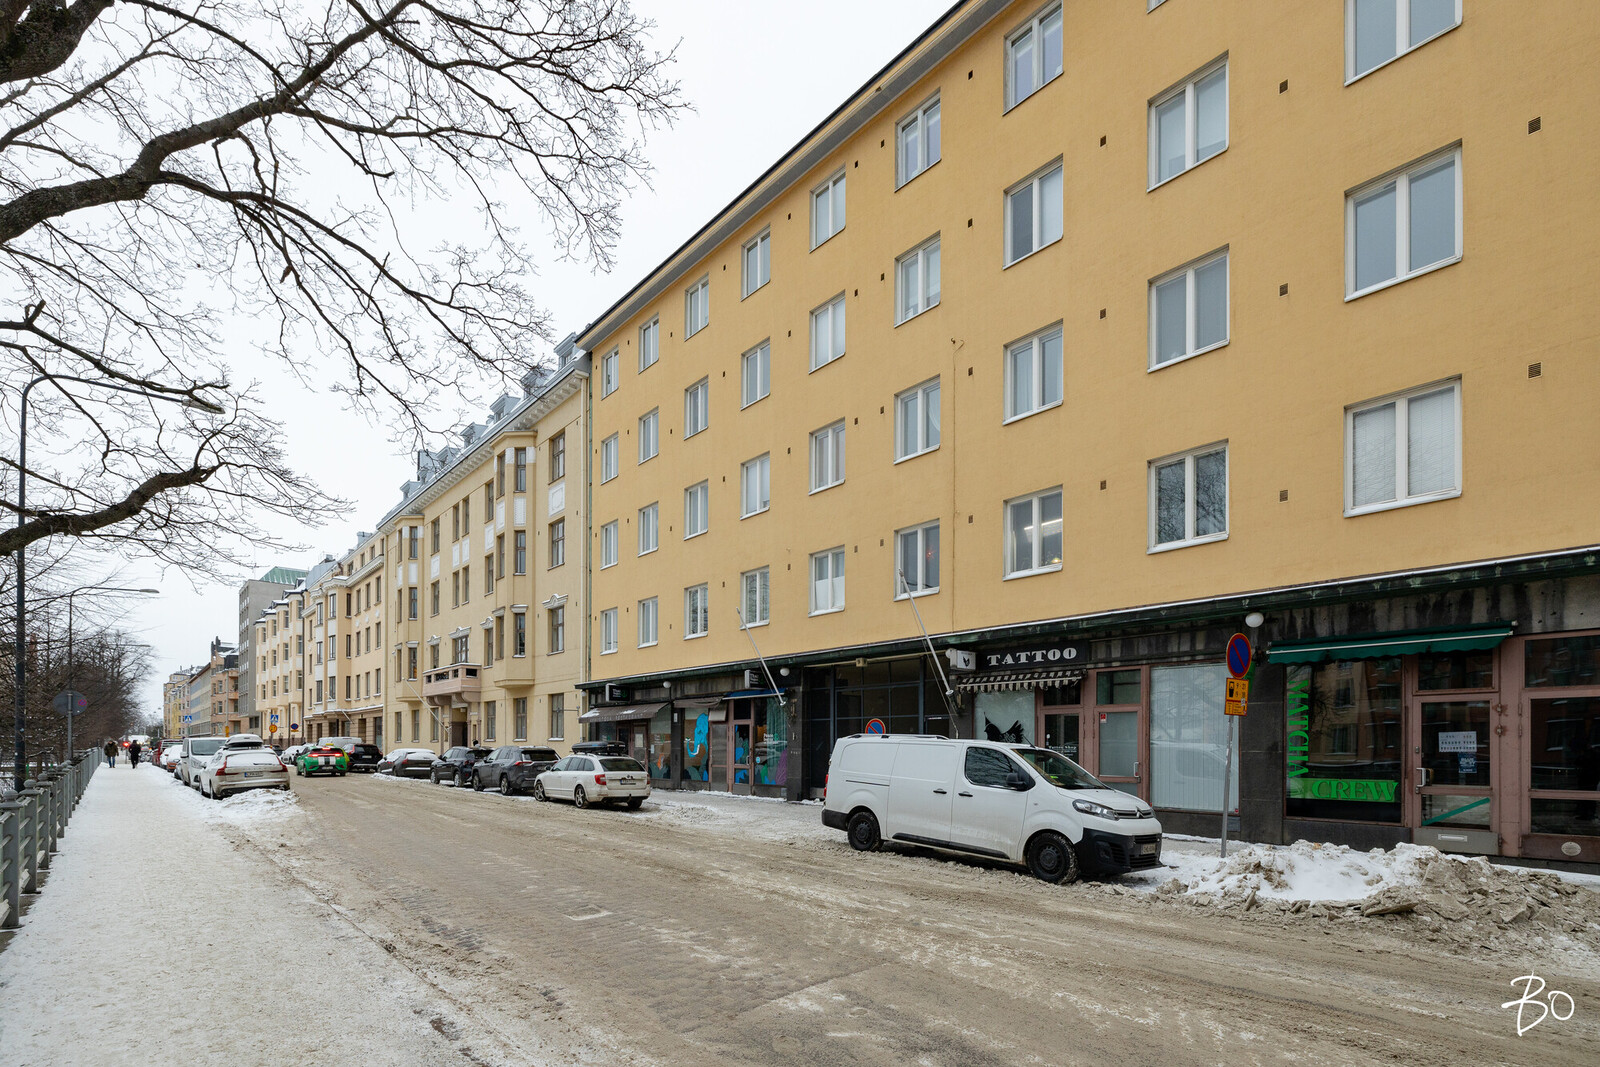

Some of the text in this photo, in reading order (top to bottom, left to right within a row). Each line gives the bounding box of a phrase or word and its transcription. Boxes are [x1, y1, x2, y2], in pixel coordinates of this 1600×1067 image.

[986, 647, 1077, 666] TATTOO
[1288, 680, 1309, 779] MATCHA
[1311, 780, 1399, 801] CREW
